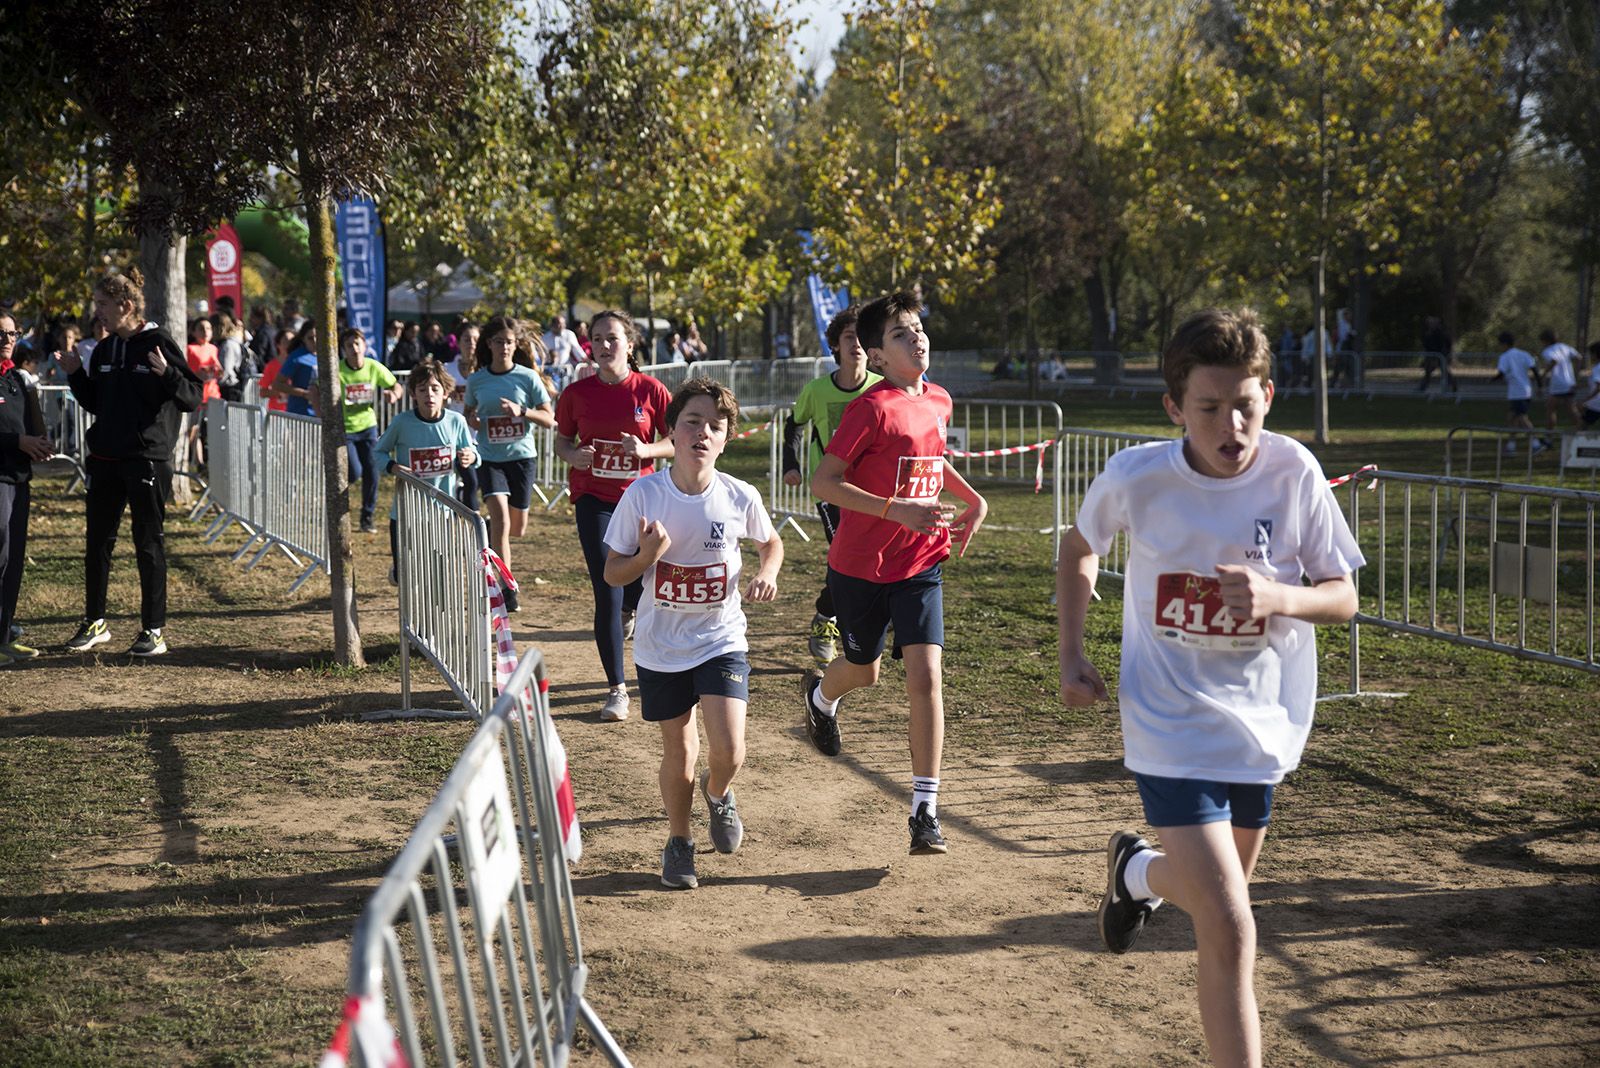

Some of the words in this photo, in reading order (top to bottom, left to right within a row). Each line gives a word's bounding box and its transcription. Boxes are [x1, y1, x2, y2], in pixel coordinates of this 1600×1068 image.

[490, 424, 522, 437] 1291
[414, 456, 451, 472] 1299
[600, 454, 633, 470] 715
[909, 476, 938, 497] 719
[703, 541, 727, 550] VIARO
[658, 580, 724, 603] 4153
